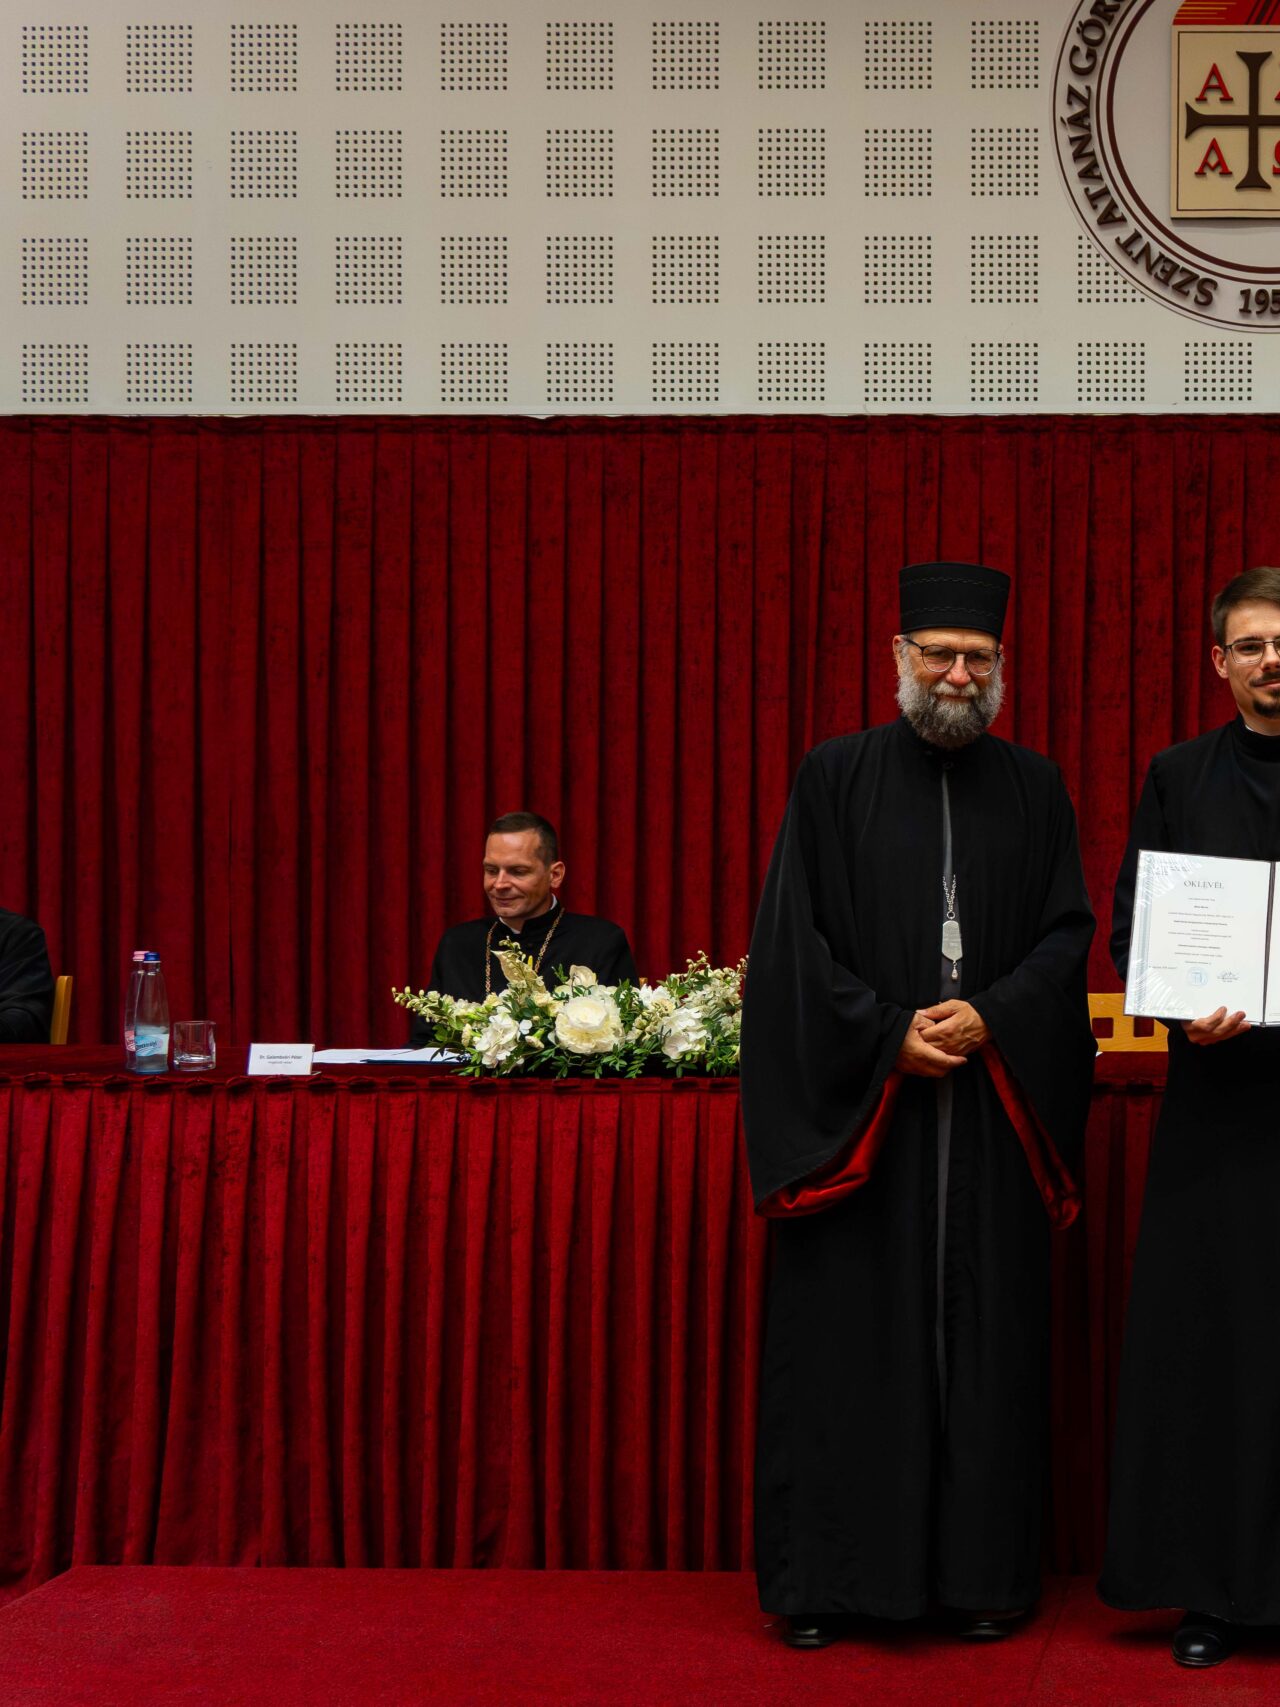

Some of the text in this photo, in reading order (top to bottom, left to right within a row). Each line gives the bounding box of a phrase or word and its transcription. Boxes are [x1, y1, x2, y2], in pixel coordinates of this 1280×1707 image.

[1060, 0, 1218, 307] SZENT ATANÁZ GÖR
